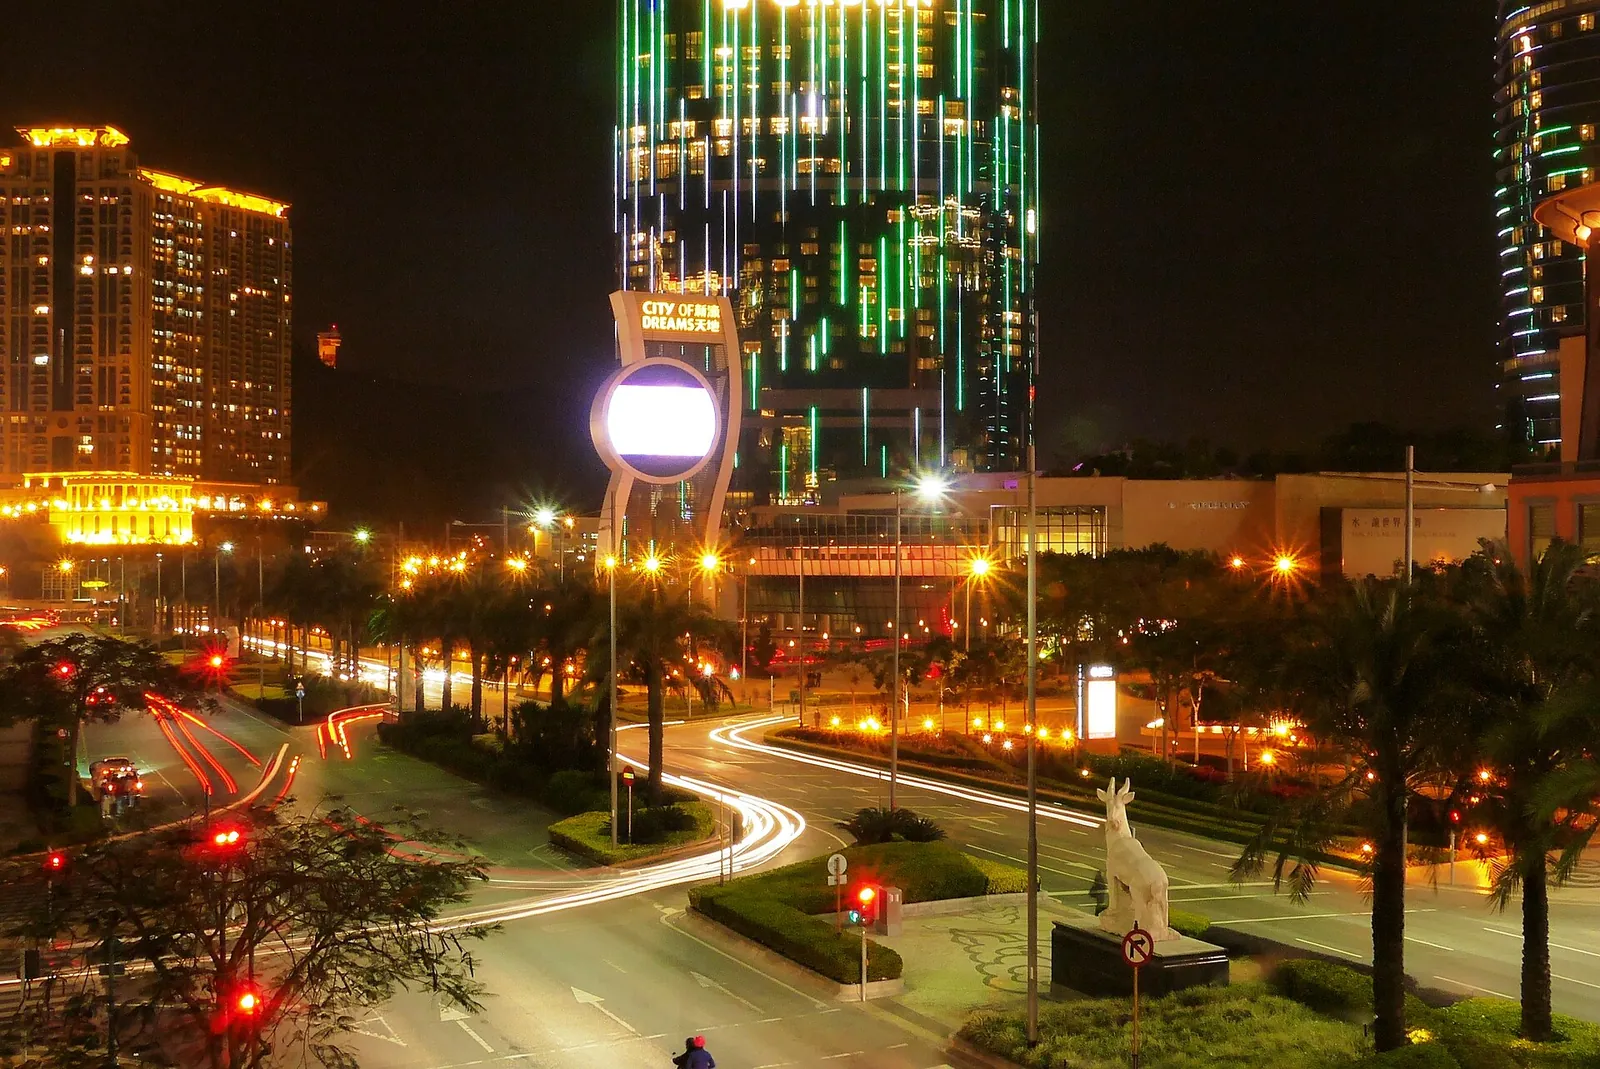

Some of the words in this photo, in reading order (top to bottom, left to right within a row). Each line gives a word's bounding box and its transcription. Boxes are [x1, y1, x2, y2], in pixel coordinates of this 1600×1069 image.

[642, 301, 675, 315] CITY
[678, 303, 694, 317] OF
[642, 315, 694, 331] DREAMS
[694, 319, 720, 332] 天地
